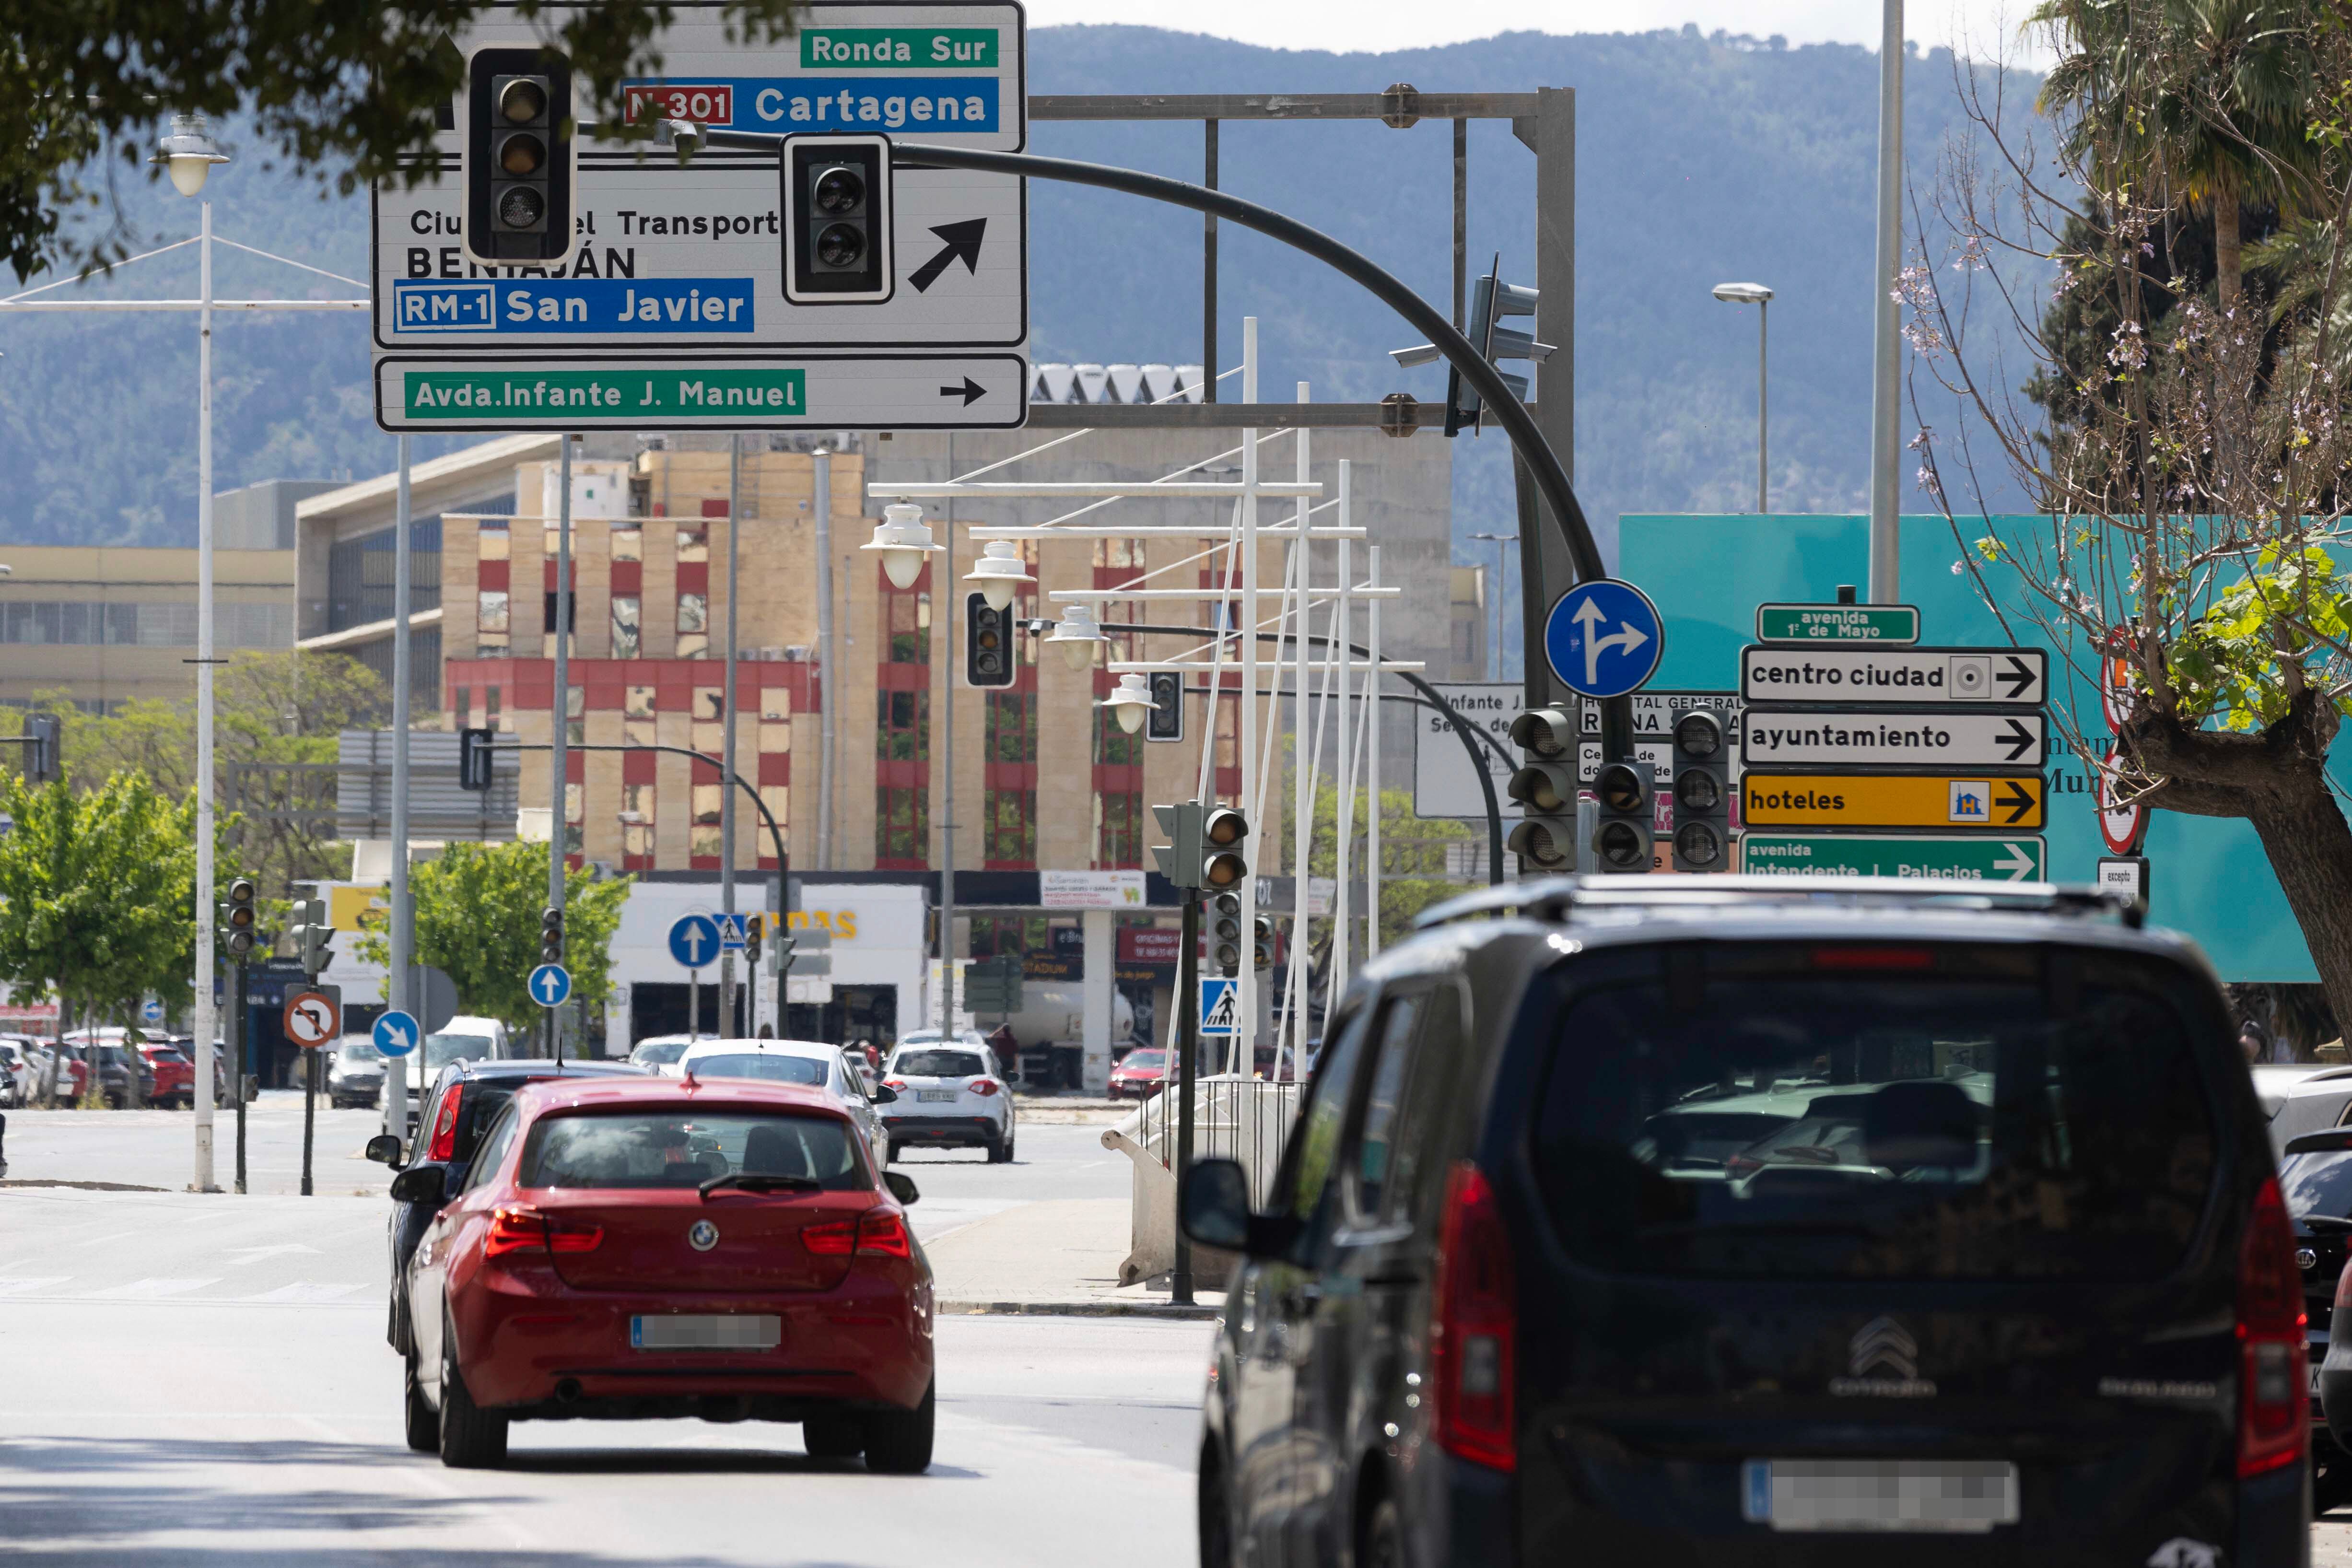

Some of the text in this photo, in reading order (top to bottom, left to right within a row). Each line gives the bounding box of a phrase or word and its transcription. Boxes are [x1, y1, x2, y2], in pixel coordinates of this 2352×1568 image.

[812, 36, 986, 61] Ronda Sur
[631, 88, 986, 128] N-301 Cartagena
[410, 210, 779, 240] Ciu el Transport
[405, 289, 744, 322] RM-1 San Javier
[639, 381, 662, 406] J.
[679, 381, 796, 406] Manuel
[1801, 610, 1869, 625] avenida
[1809, 624, 1828, 637] de
[1837, 625, 1880, 639] Mayo
[1752, 663, 1944, 687] centro ciudad
[1446, 695, 1503, 710] Infante
[1669, 697, 1745, 709] GENERAL
[1752, 725, 1951, 749] ayuntamiento
[1639, 750, 1655, 761] de
[1750, 790, 1845, 809] hoteles
[1750, 843, 1811, 856] avenida
[1749, 863, 1859, 876] Intendente
[1898, 864, 1982, 880] Palacios
[2108, 870, 2130, 885] excepto
